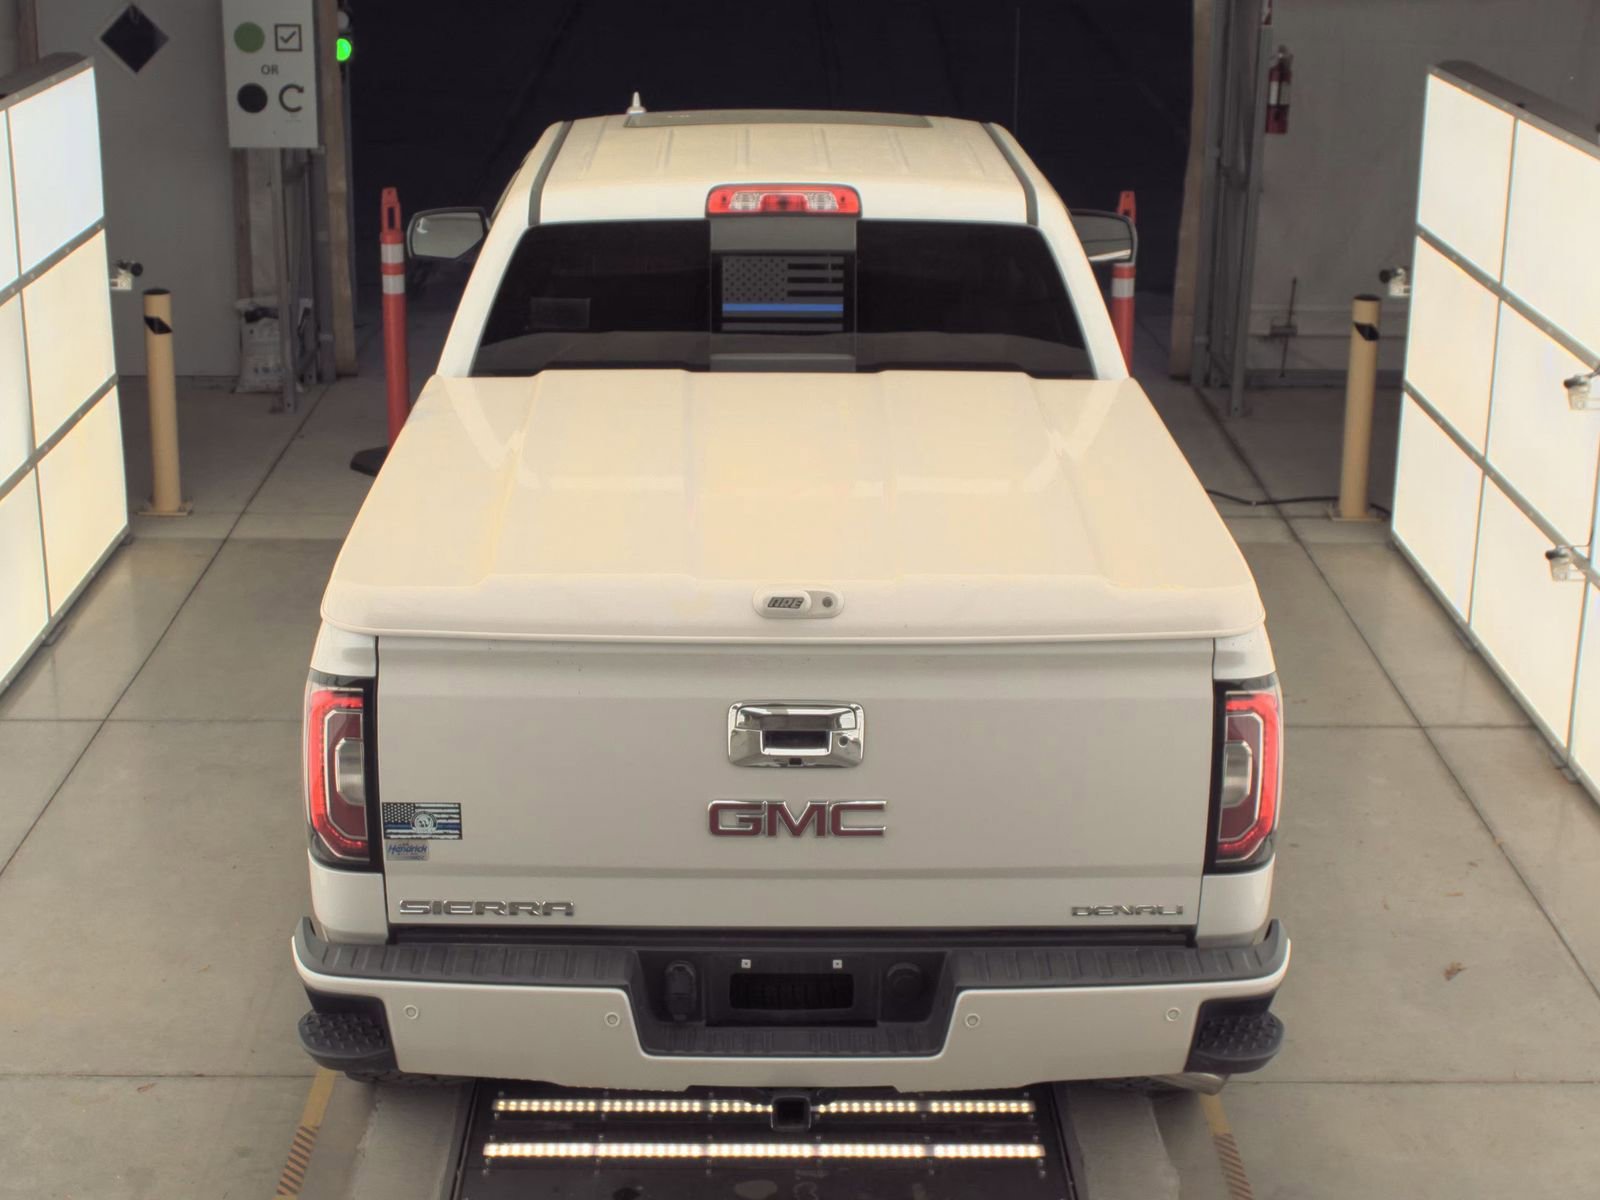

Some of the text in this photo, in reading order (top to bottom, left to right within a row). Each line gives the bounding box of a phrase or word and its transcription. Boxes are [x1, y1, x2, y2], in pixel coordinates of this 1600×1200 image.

[260, 64, 279, 75] OR
[707, 800, 886, 837] GMC
[399, 899, 574, 917] SIERRA
[1071, 904, 1184, 917] DENALI
